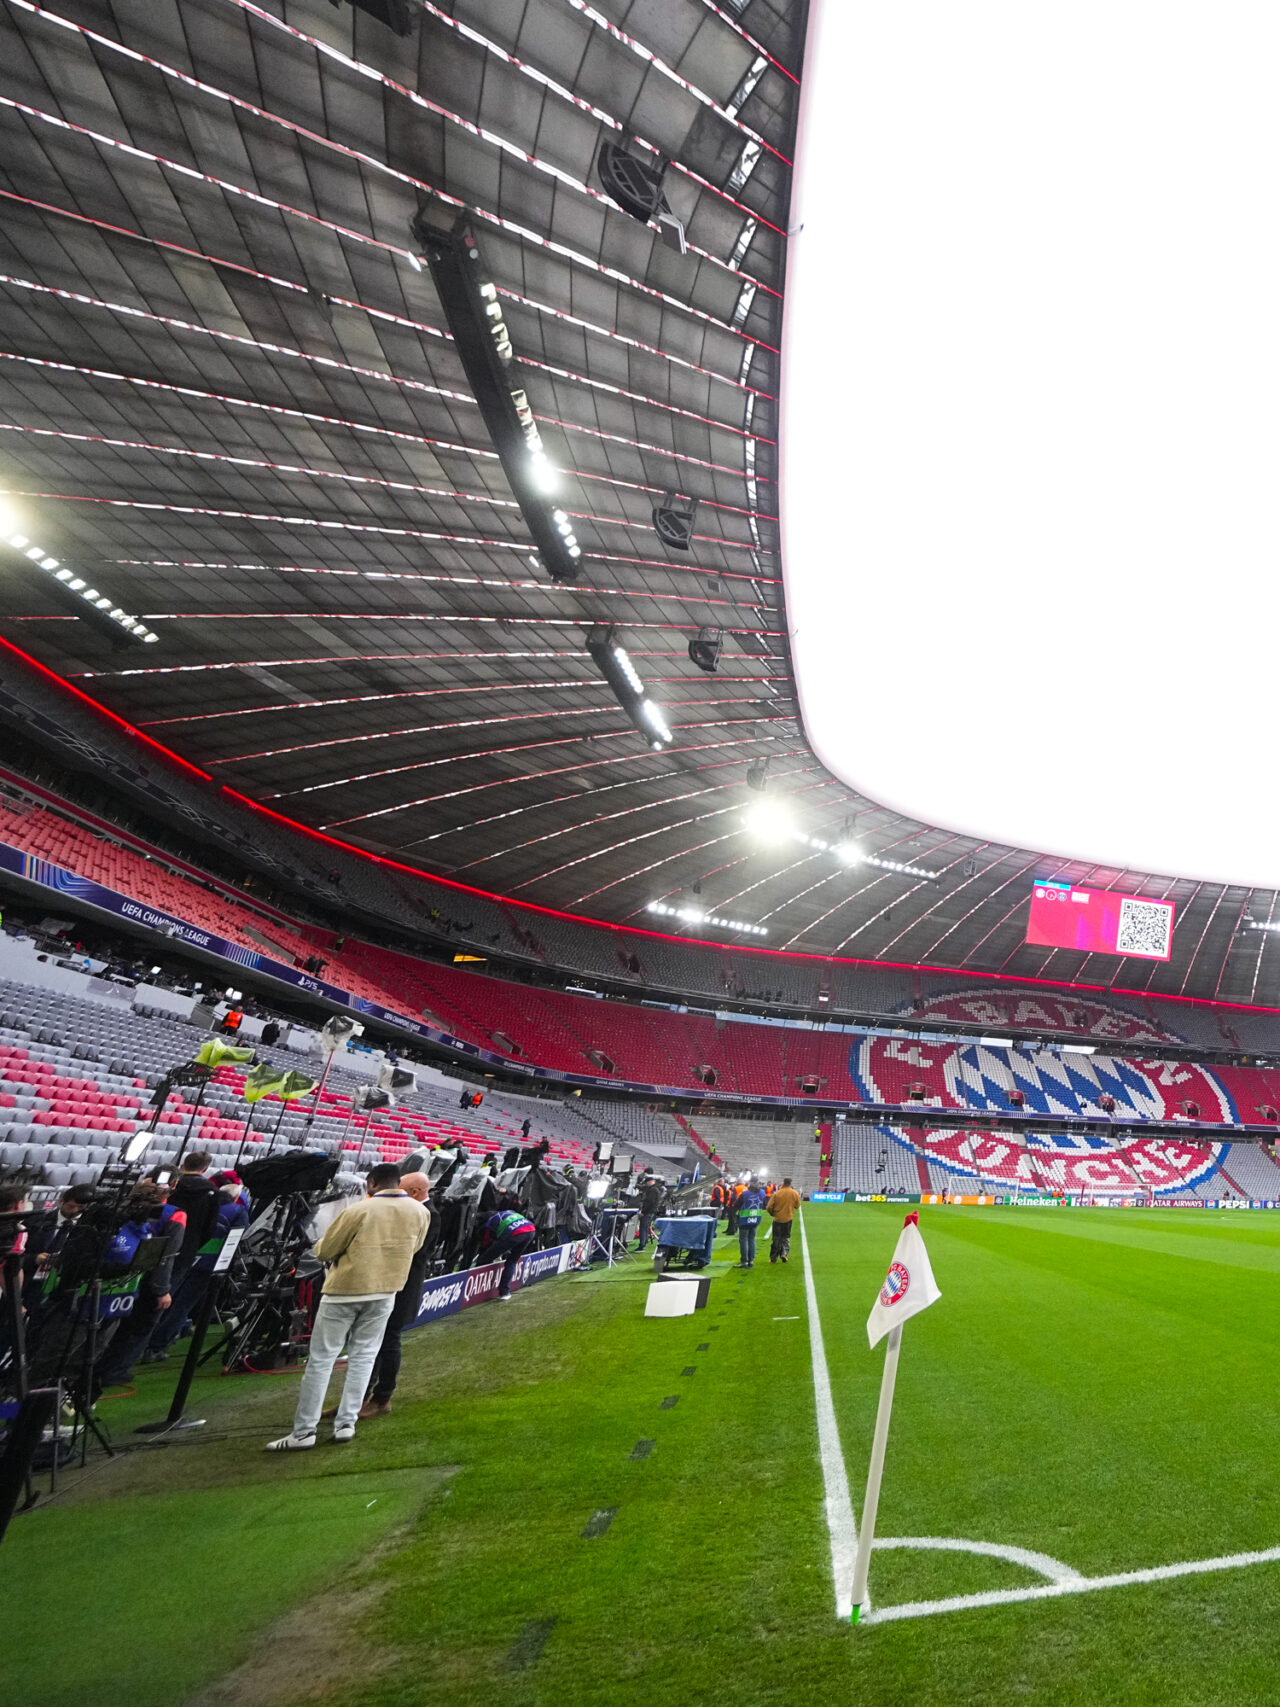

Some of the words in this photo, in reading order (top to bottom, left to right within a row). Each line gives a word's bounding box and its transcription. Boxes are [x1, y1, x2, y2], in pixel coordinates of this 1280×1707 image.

[122, 902, 143, 919] UEFA
[184, 929, 211, 946] LEAGUE
[855, 1193, 888, 1202] bet365
[1009, 1196, 1058, 1207] Heineken
[1146, 1200, 1171, 1208] QATAR
[1171, 1200, 1203, 1208] AIRWAYS
[1219, 1200, 1250, 1209] PEPSI
[530, 1253, 560, 1277] crypto.com
[464, 1270, 495, 1301] QATAR
